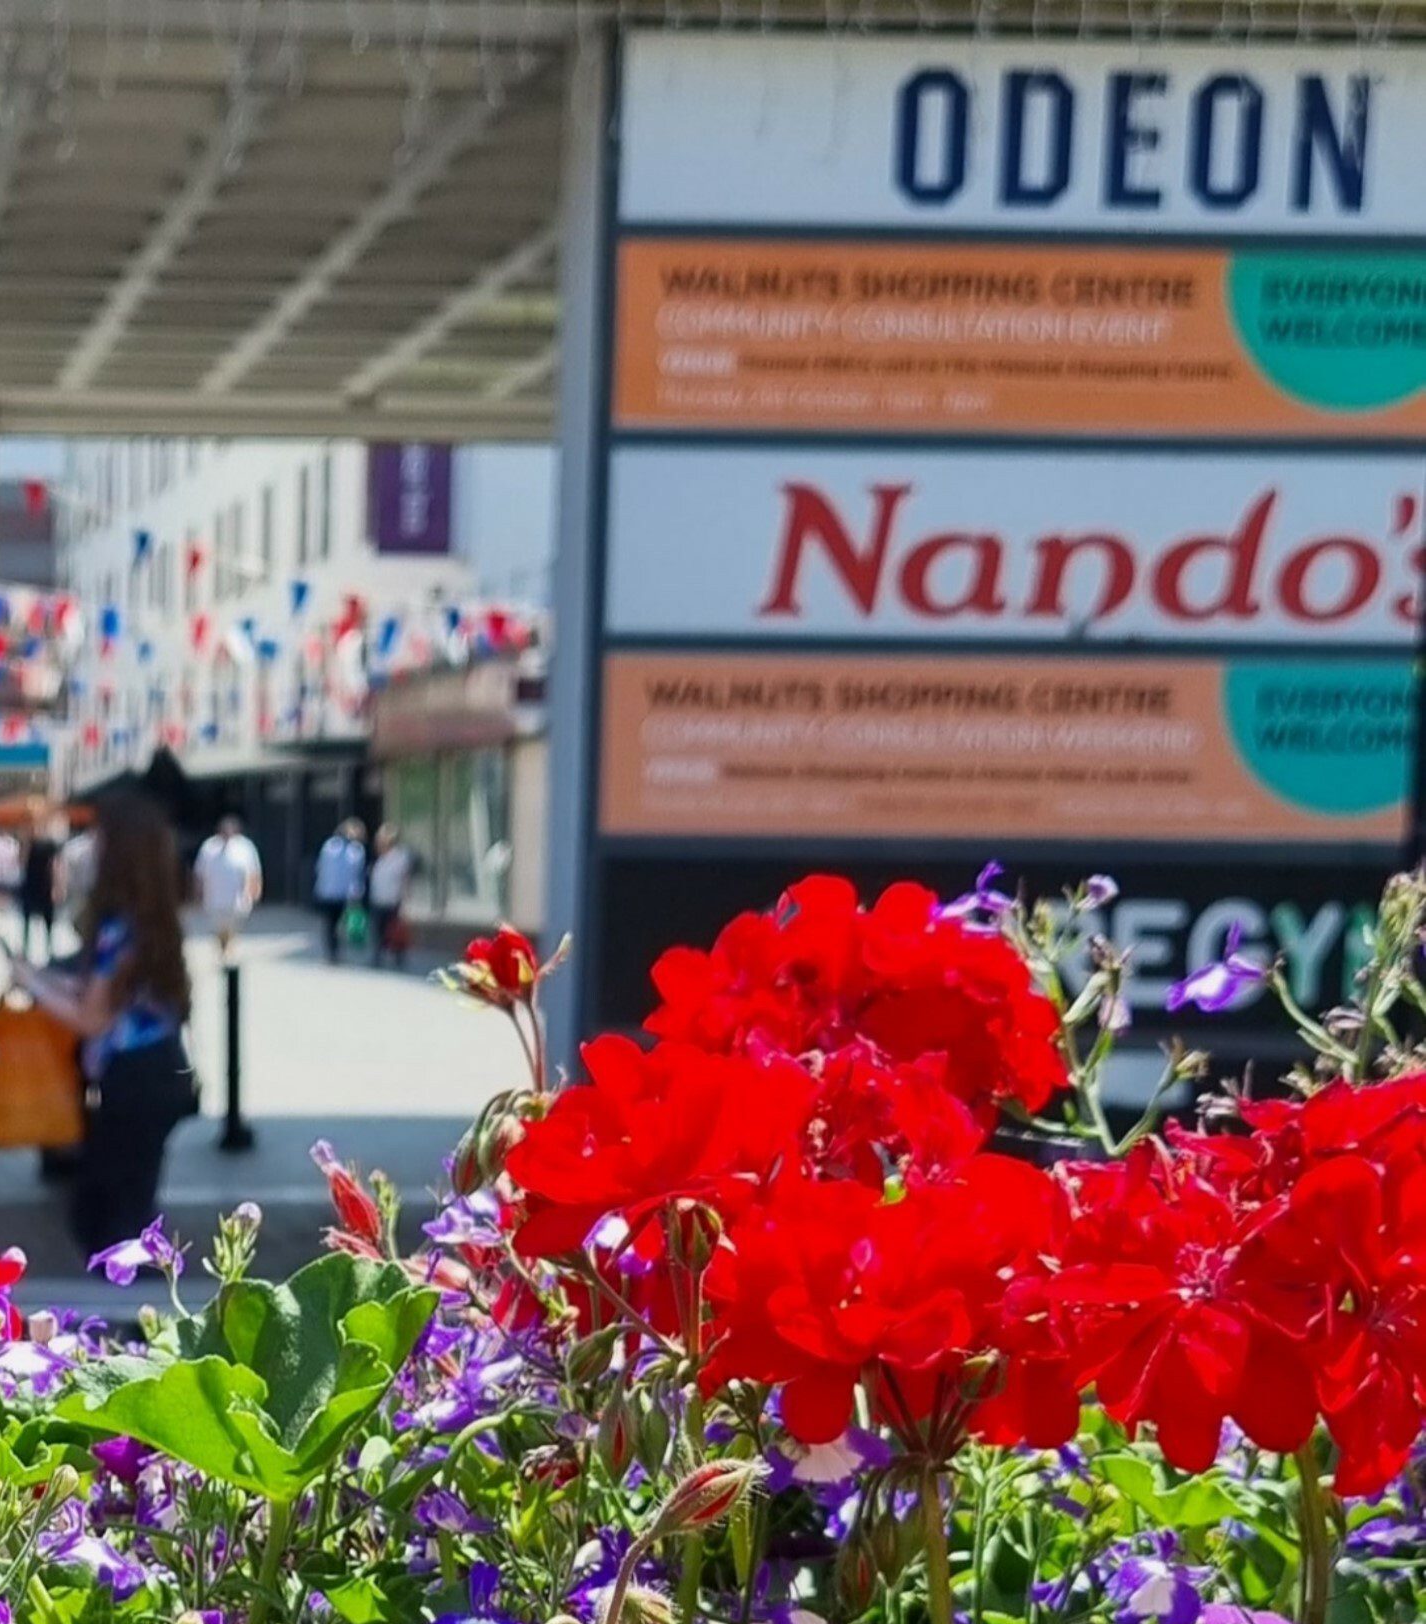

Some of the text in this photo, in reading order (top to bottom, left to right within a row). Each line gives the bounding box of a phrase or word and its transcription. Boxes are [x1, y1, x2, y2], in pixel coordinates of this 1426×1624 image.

[896, 68, 1370, 212] ODEON
[661, 268, 1197, 307] WALNUTS SHOPPING CENTRE
[1264, 273, 1426, 306] EVERYON
[658, 305, 837, 341] COMMUNITY
[1076, 312, 1169, 344] EVENT
[646, 679, 1175, 716] WALNUTS SHOPPING CENTRE
